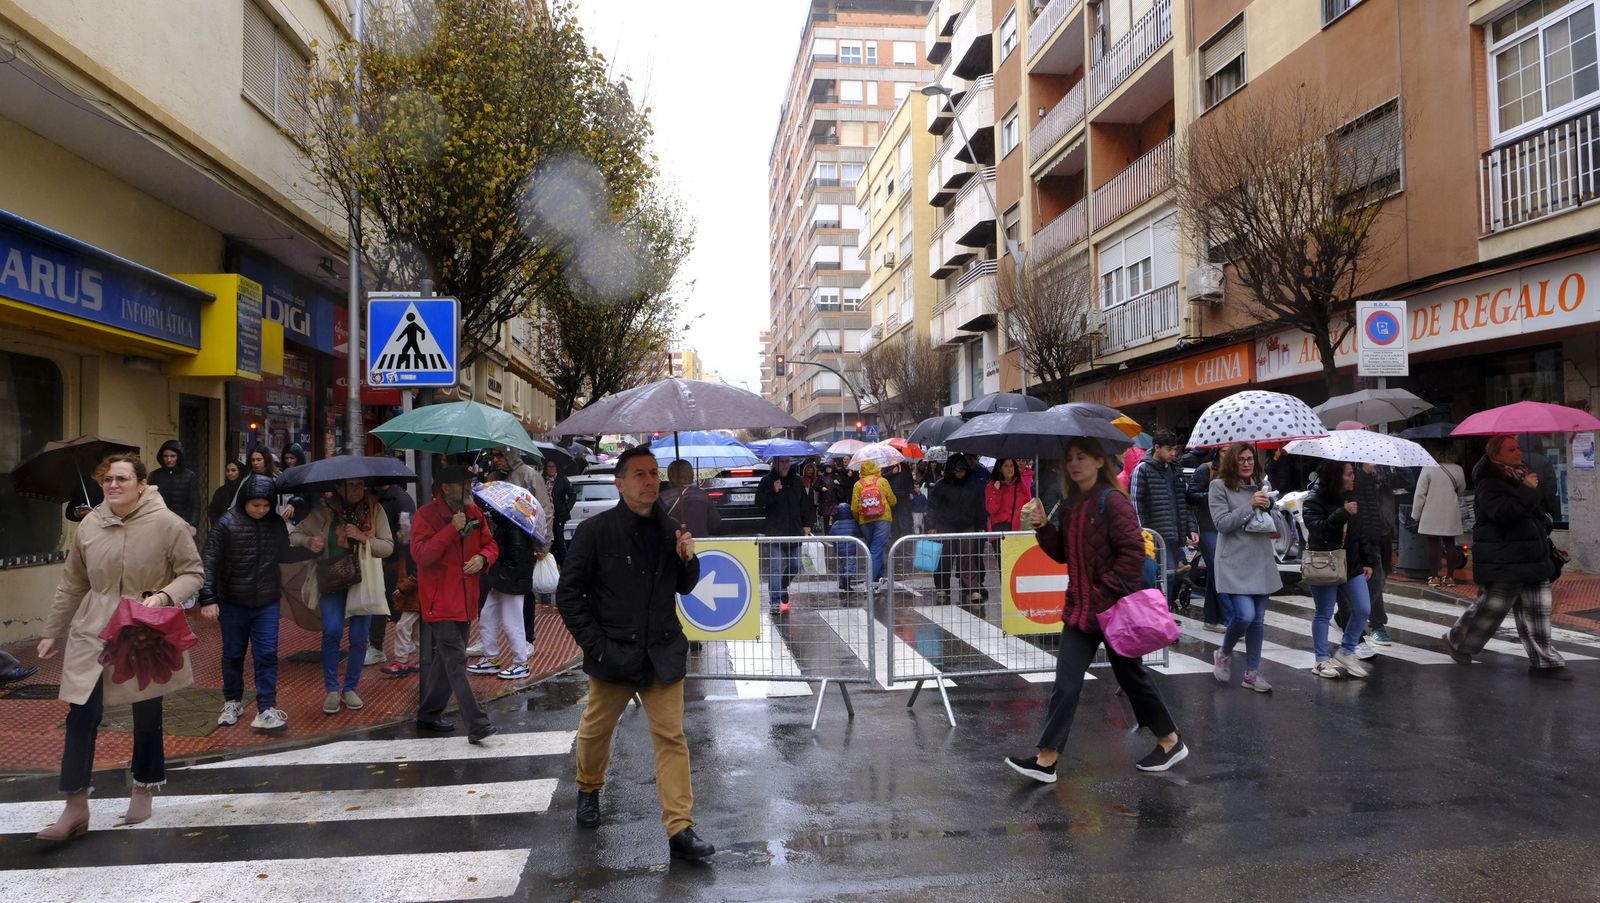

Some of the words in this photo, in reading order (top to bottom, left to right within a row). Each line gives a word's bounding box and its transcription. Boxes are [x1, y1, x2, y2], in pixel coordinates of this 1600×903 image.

[0, 247, 103, 311] ARUS
[121, 298, 193, 338] INFORMÁTICA
[266, 294, 311, 337] DIGI
[1411, 304, 1443, 340] DE
[1450, 272, 1586, 332] REGALO
[1194, 351, 1242, 385] CHINA
